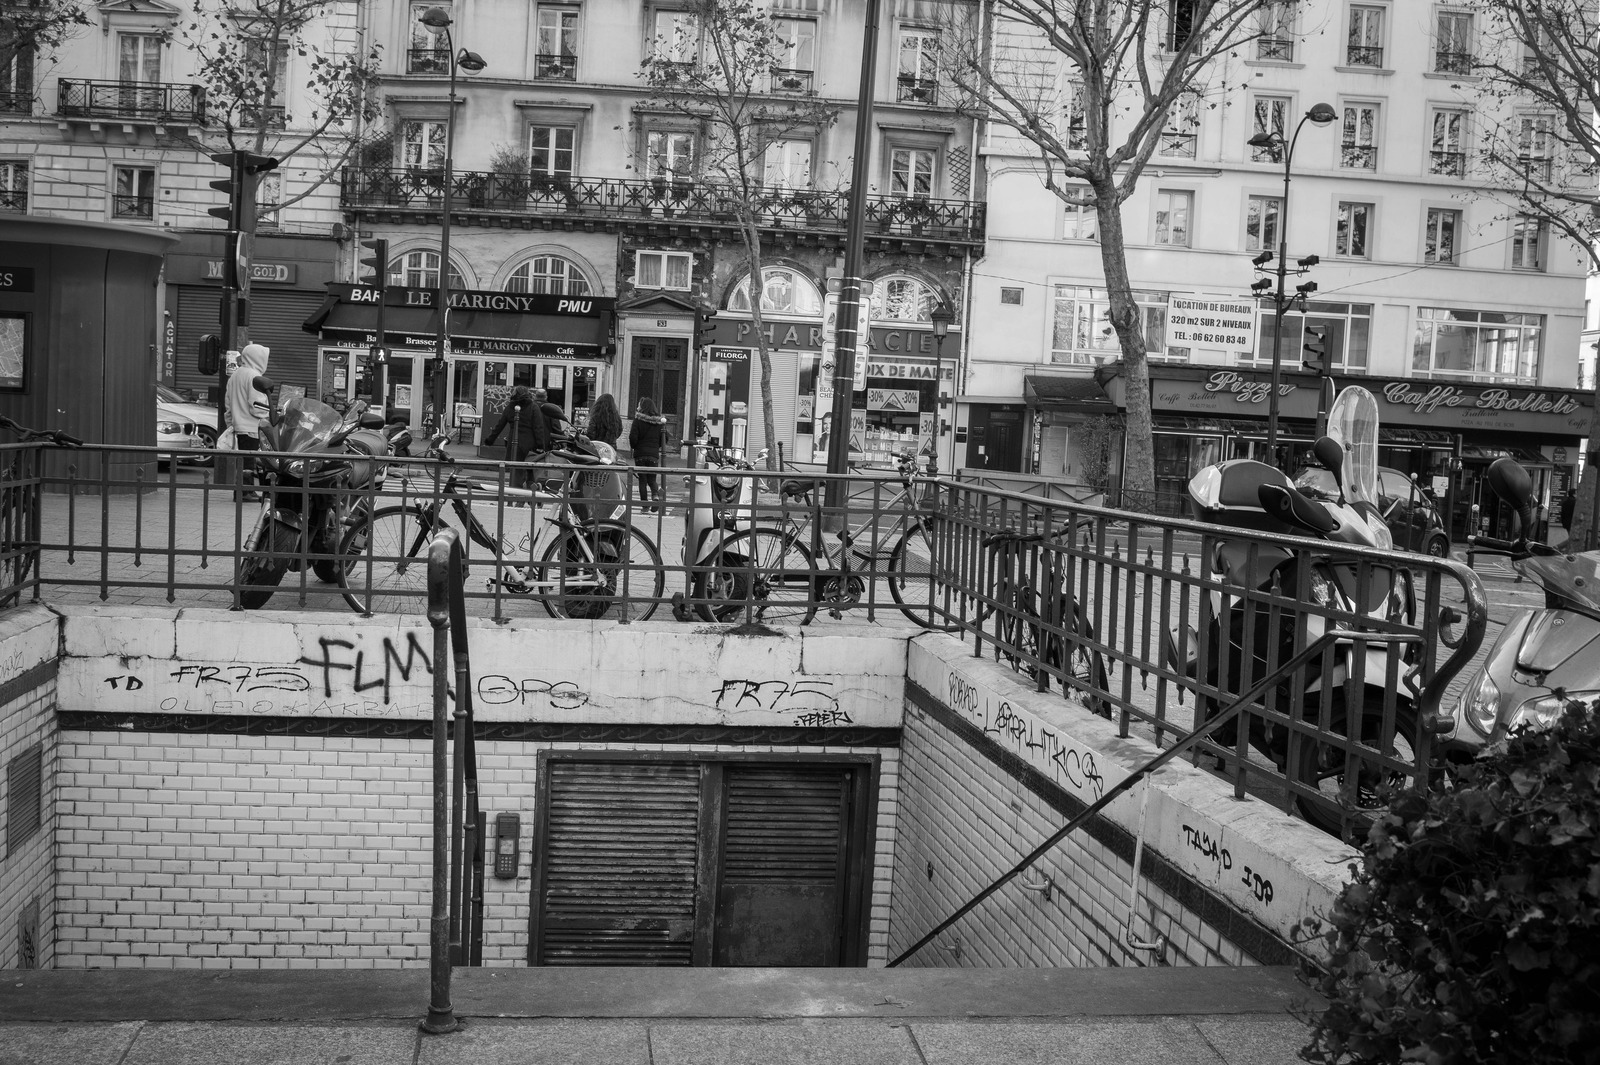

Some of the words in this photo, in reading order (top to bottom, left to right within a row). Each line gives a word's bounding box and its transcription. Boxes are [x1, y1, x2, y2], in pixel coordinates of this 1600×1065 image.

[253, 264, 289, 281] GOLD
[0, 273, 13, 286] S
[350, 288, 380, 302] BAR
[406, 291, 432, 306] LE
[446, 293, 534, 311] MARIGNY
[557, 299, 593, 313] PMU
[1173, 299, 1209, 311] LOCATION
[1209, 303, 1219, 312] DE
[1219, 304, 1252, 315] BUREAUX
[1170, 315, 1186, 325] 320
[1187, 317, 1199, 326] m2
[1200, 317, 1215, 327] SUR
[1215, 319, 1221, 328] 2
[1221, 320, 1252, 330] NIVEAUX
[366, 334, 377, 343] Ba
[406, 336, 437, 347] Brasser
[736, 322, 934, 353] PHARACIE
[1192, 333, 1202, 341] 06
[1203, 334, 1214, 343] 62
[1214, 334, 1225, 343] 60
[1225, 335, 1236, 344] 83
[1236, 336, 1246, 345] 48
[468, 340, 481, 349] LE
[482, 341, 533, 352] MARIGNY
[556, 346, 575, 355] Café
[715, 351, 748, 360] FILORGA
[888, 365, 906, 377] DE
[868, 391, 884, 402] -30%
[901, 392, 918, 404] -30%
[104, 675, 144, 691] TD
[169, 665, 310, 693] FR75
